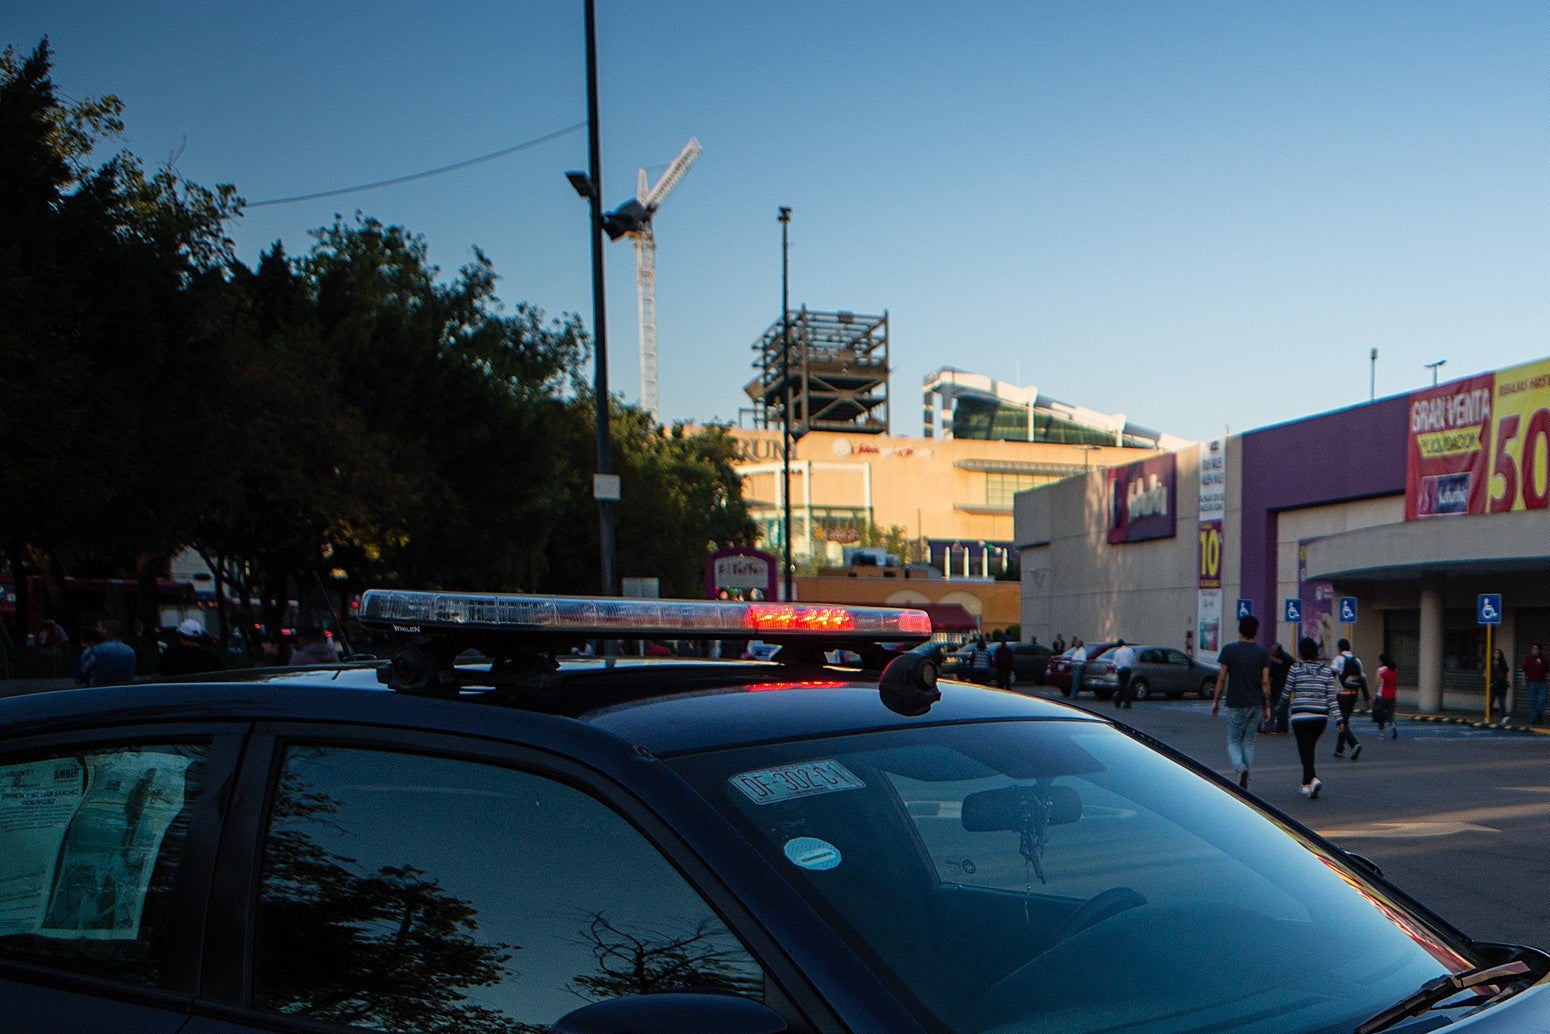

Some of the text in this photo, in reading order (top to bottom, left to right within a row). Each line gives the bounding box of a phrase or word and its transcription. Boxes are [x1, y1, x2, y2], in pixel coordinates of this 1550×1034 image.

[1446, 387, 1491, 428] VENTA
[737, 437, 799, 463] RUM
[1200, 529, 1220, 577] 10
